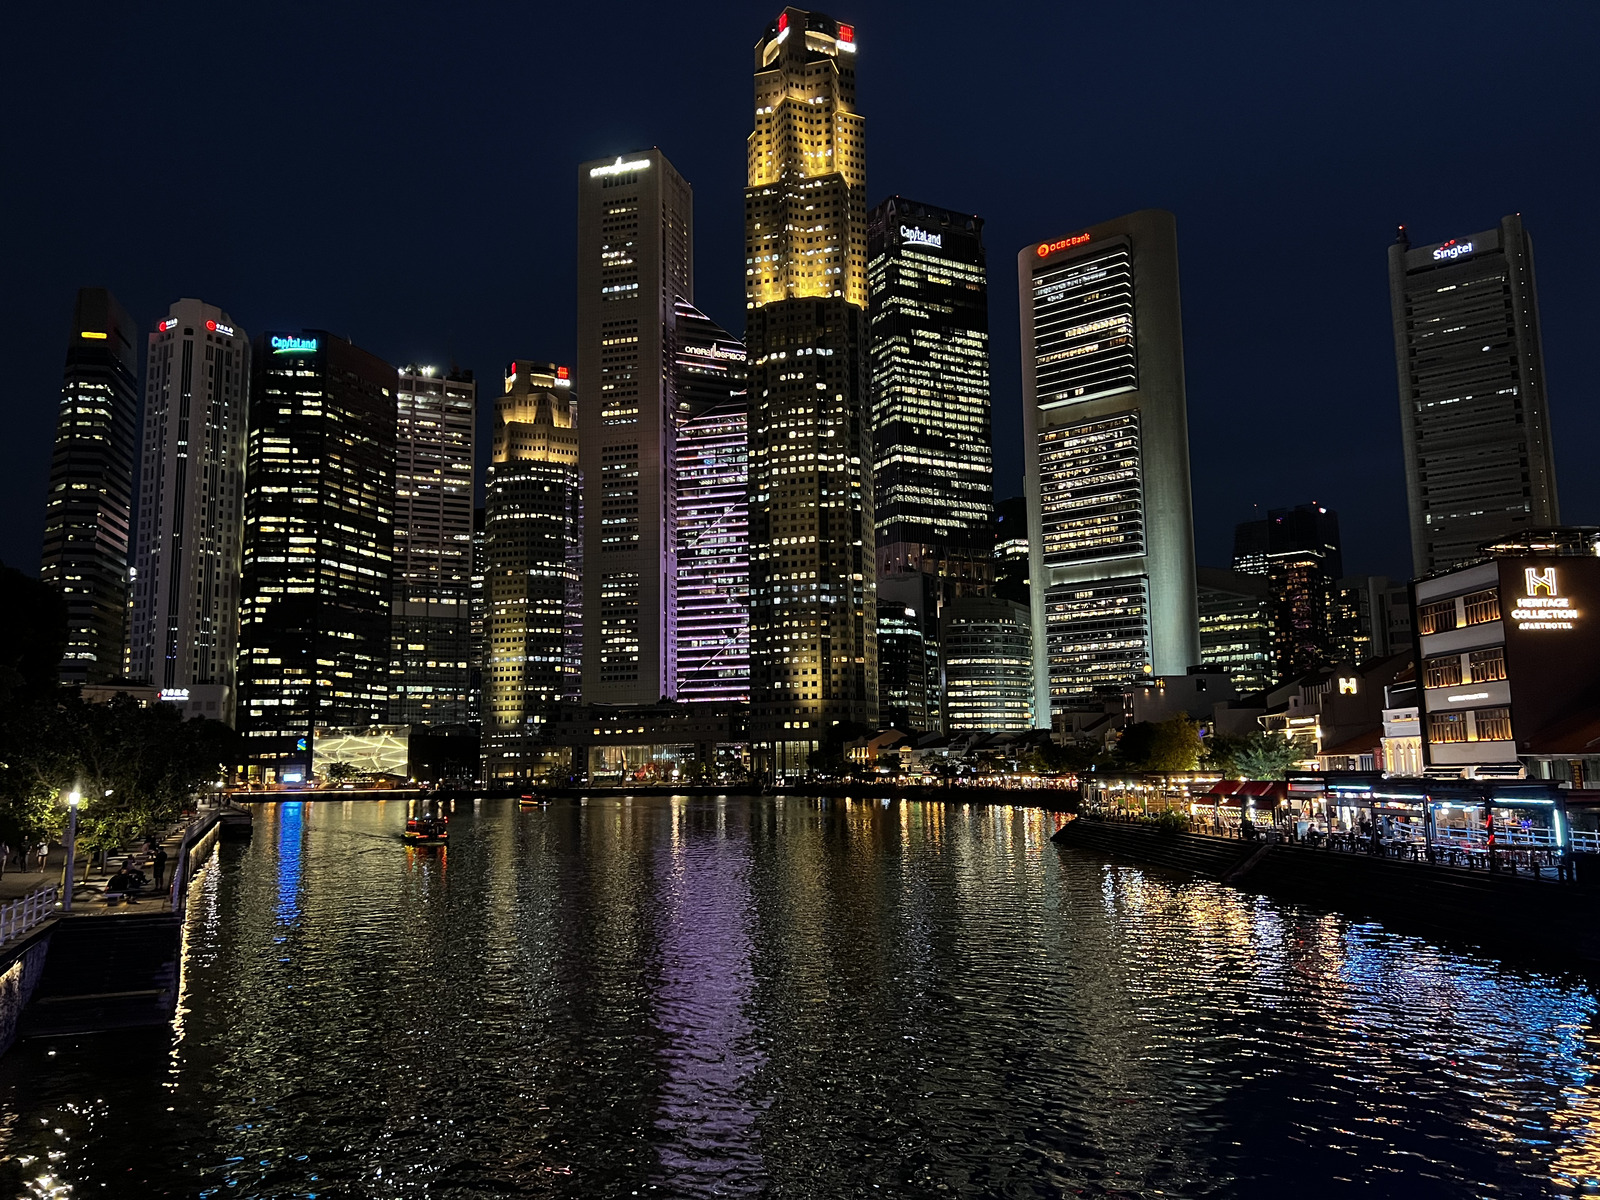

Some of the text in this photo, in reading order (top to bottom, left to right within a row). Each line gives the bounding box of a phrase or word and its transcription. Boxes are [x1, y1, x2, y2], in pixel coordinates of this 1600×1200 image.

[900, 225, 942, 246] CapitaLand
[1050, 232, 1090, 251] OCBC Bank
[1433, 242, 1473, 260] Singtel
[271, 335, 317, 350] CapitaLand
[1517, 598, 1569, 608] HERITAGE
[1511, 609, 1578, 619] COLLECTION
